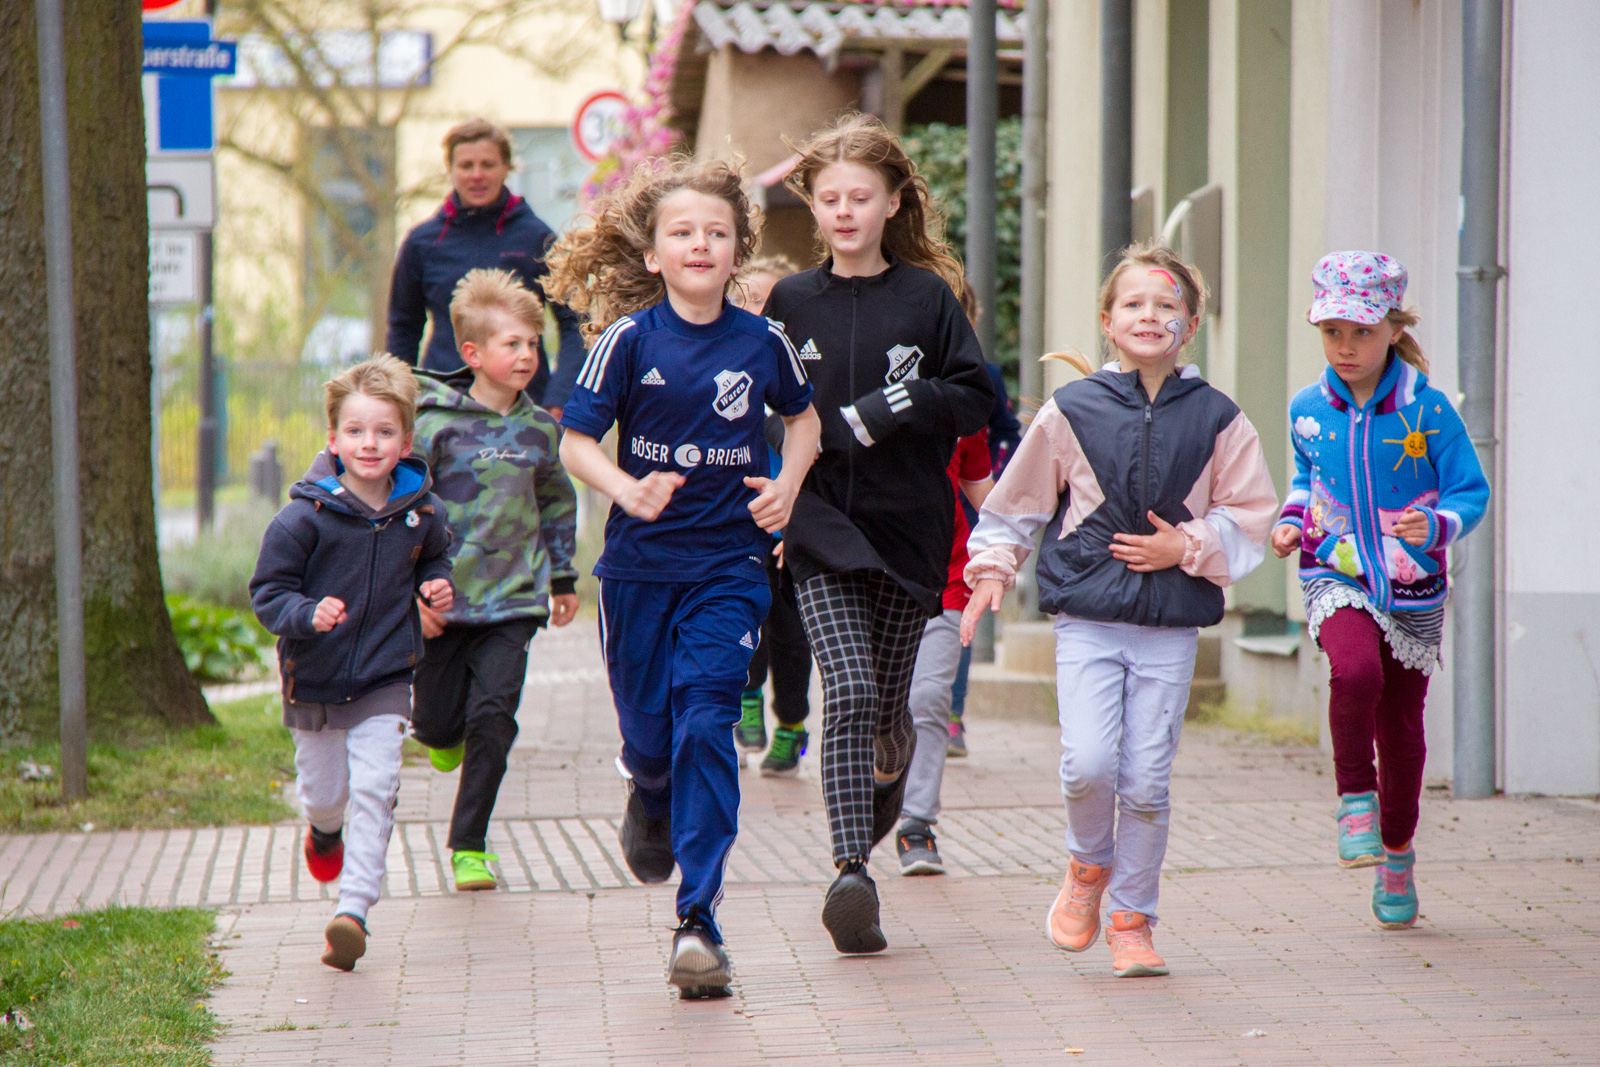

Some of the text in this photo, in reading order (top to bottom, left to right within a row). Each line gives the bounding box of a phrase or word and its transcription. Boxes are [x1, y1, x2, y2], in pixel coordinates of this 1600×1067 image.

[894, 350, 904, 365] SV
[892, 356, 916, 380] Waren
[640, 378, 666, 386] adidas
[722, 376, 732, 391] SV
[720, 382, 746, 407] Waren
[631, 435, 752, 466] BÖSER BRIEHN
